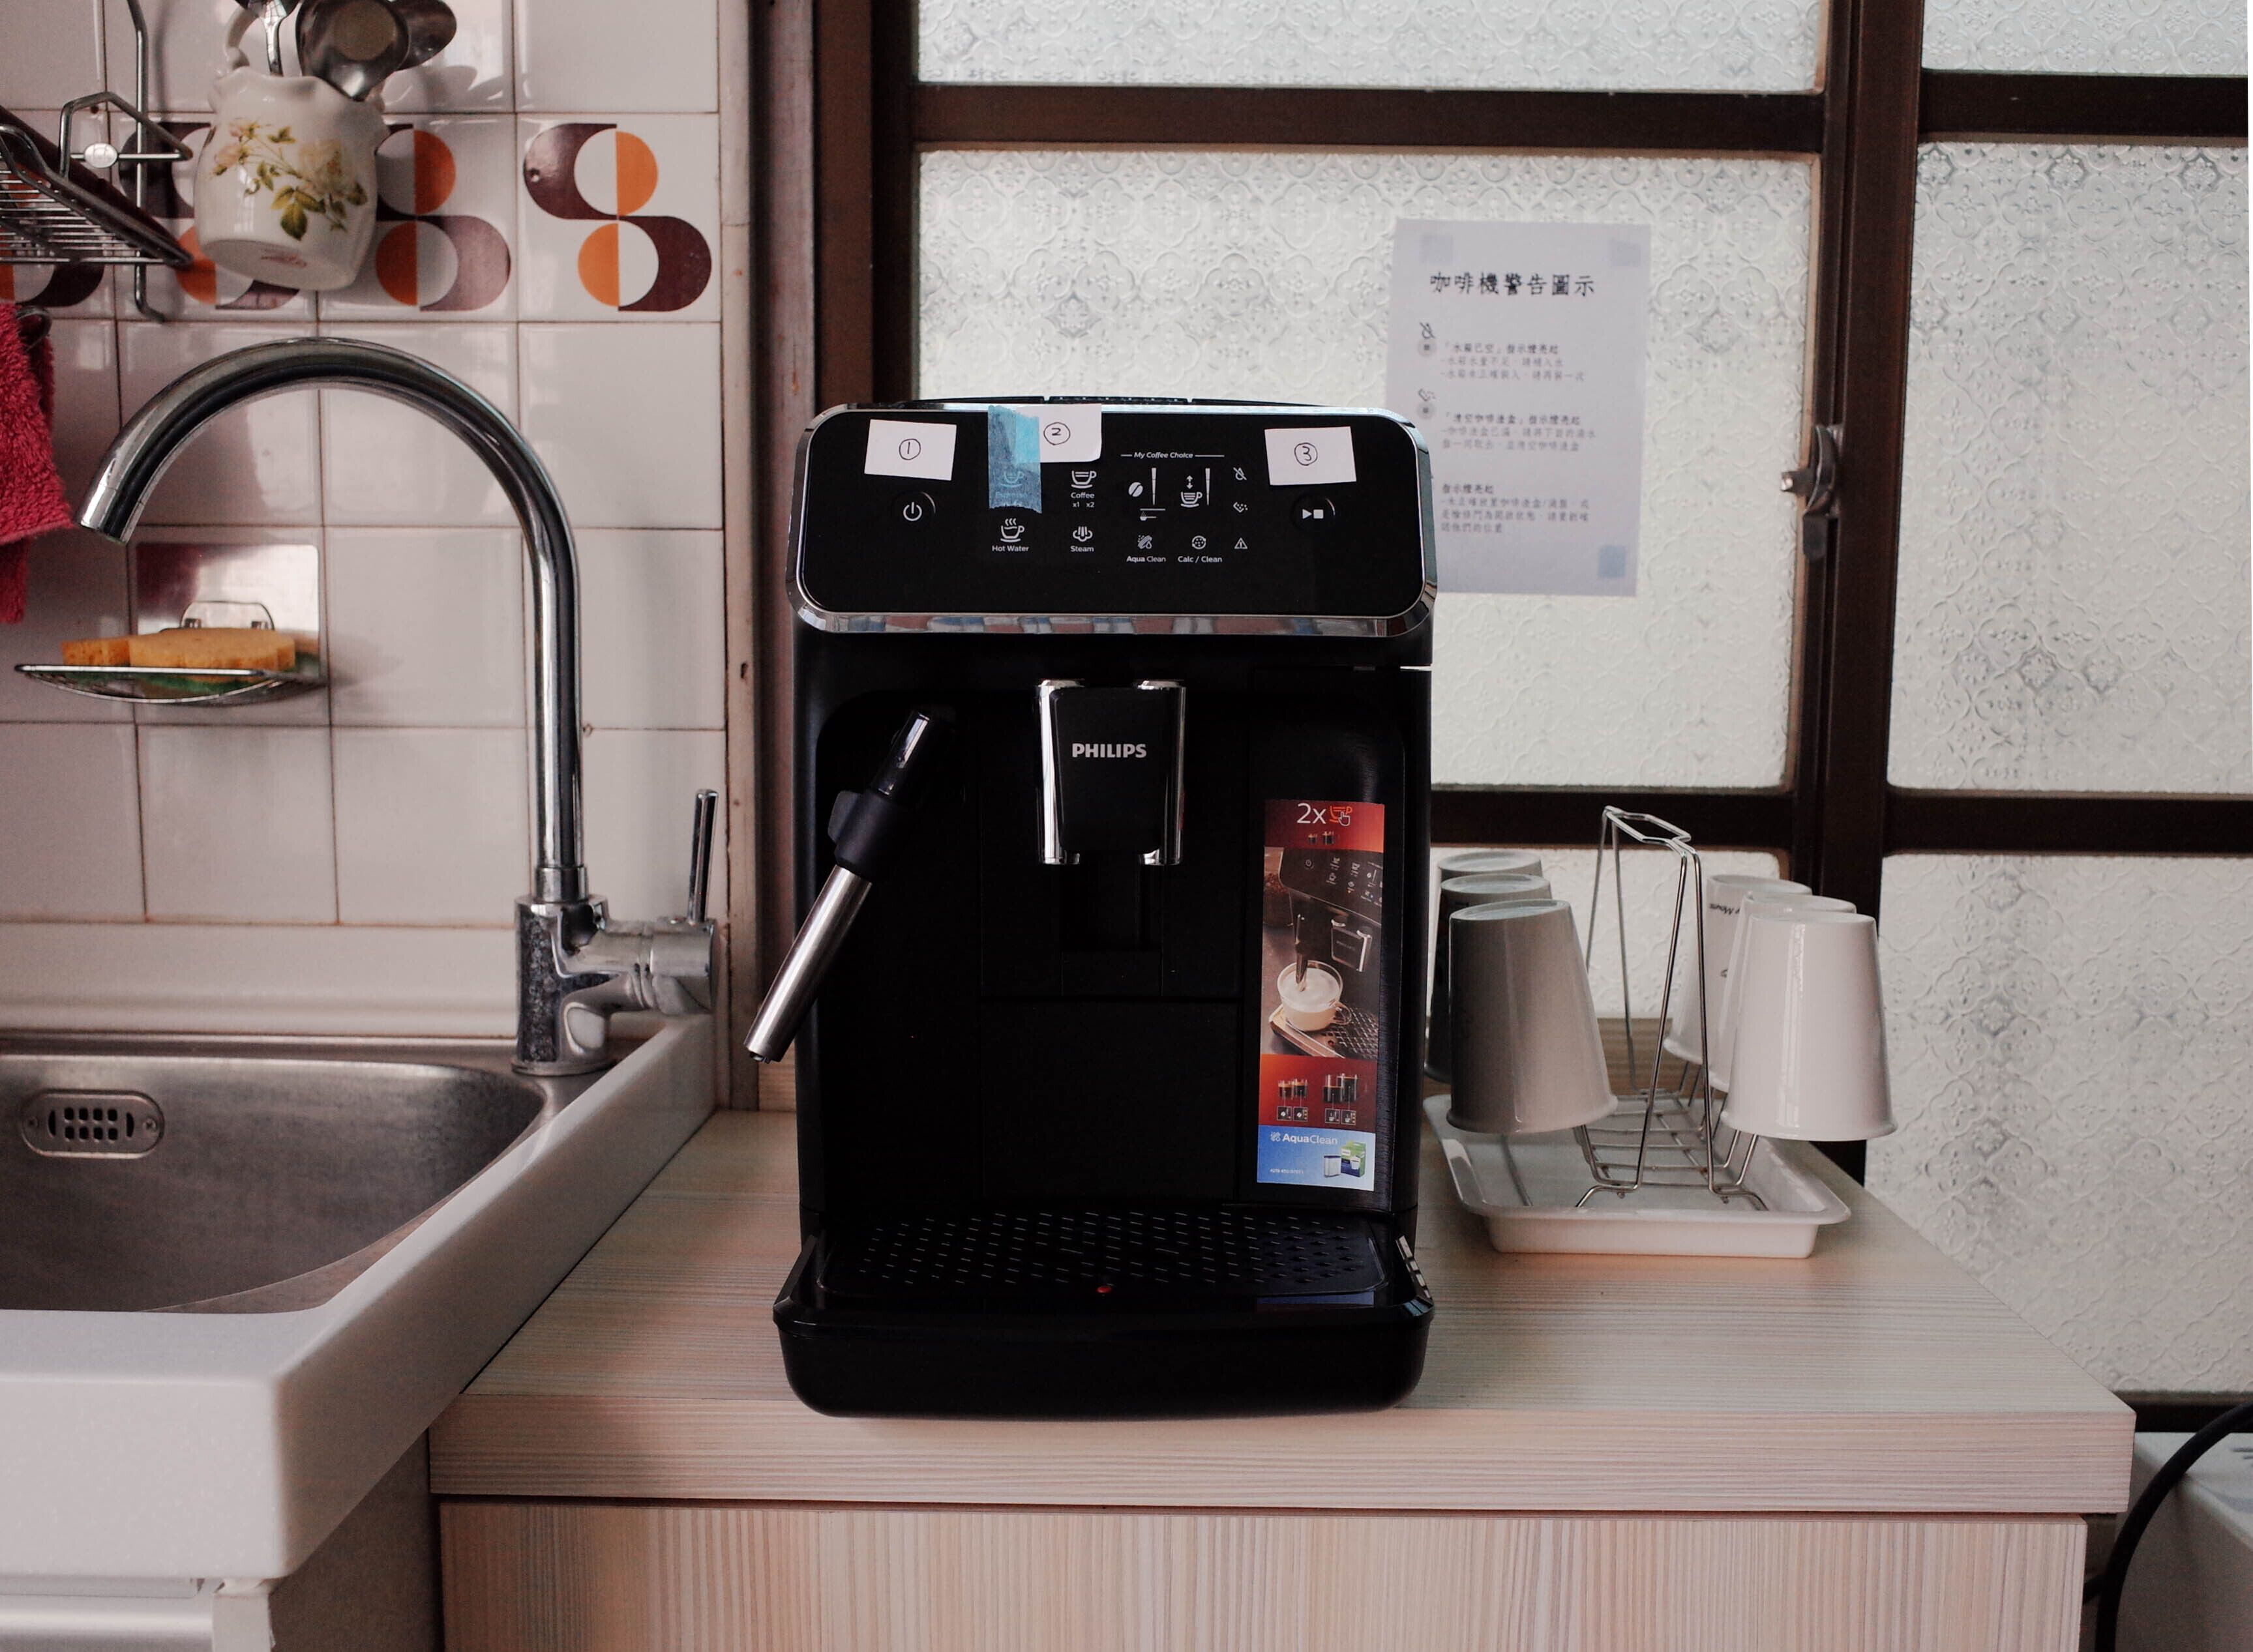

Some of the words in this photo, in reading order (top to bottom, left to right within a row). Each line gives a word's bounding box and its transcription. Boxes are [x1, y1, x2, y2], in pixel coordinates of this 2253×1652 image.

[1430, 271, 1594, 297] 咖啡機警告圖示
[1126, 555, 1146, 564] Aqua
[1071, 743, 1147, 758] PHILIPS
[1296, 803, 1327, 825] 2x
[1282, 1133, 1337, 1145] AquaClean
